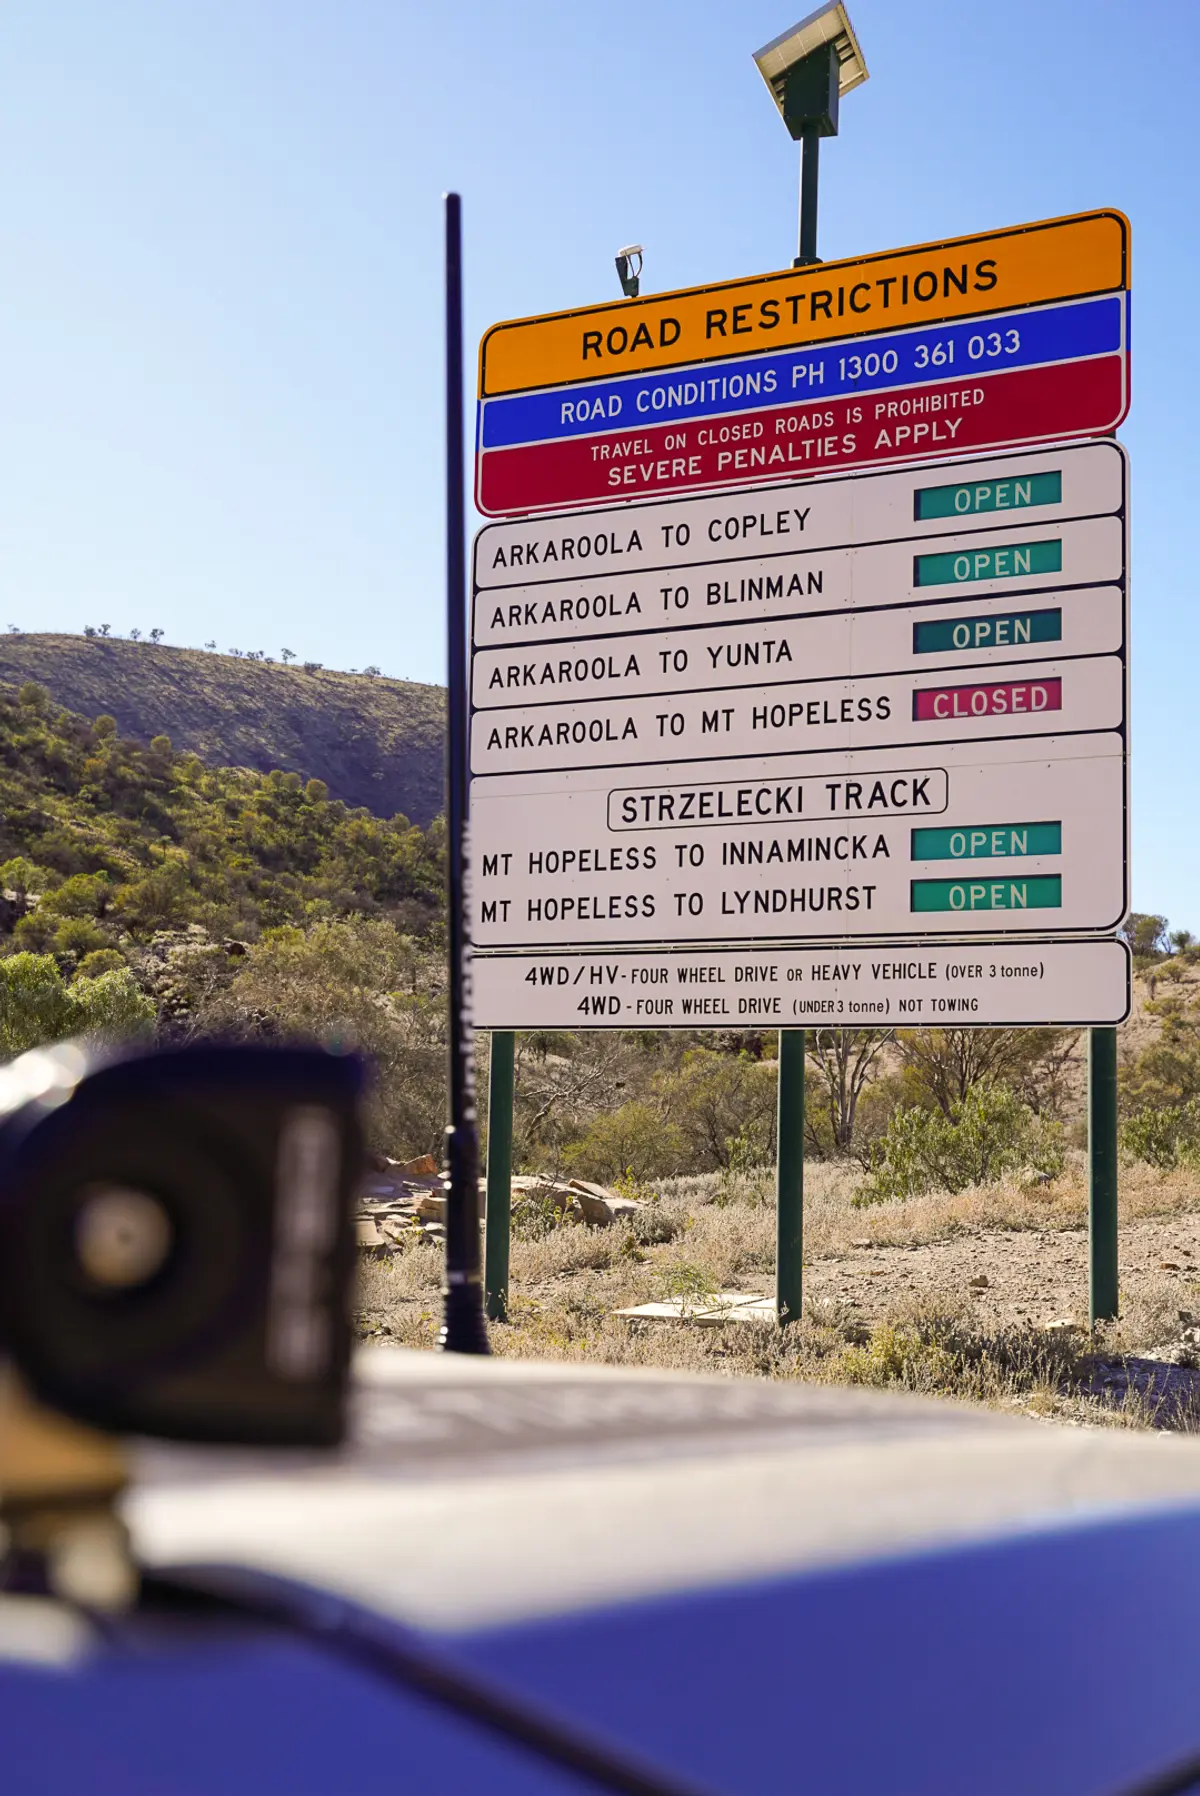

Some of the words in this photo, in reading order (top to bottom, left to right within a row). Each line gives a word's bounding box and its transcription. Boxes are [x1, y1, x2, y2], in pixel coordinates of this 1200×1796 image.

[583, 318, 680, 360] ROAD
[706, 258, 999, 340] RESTRICTIONS
[562, 395, 622, 424] ROAD
[636, 370, 777, 411] CONDITIONS
[793, 362, 823, 388] PH
[840, 350, 897, 380] 1300
[914, 340, 953, 368] 361
[968, 330, 1020, 359] 033
[591, 439, 652, 461] TRAVEL
[664, 432, 688, 450] ON
[698, 423, 763, 445] CLOSED
[774, 412, 835, 434] ROADS
[847, 407, 862, 423] IS
[876, 389, 984, 419] PROHIBITED
[608, 454, 702, 486] SEVERE
[718, 434, 857, 471] PENALTIES
[875, 418, 962, 449] APPLY
[953, 481, 1033, 514] OPEN
[493, 530, 642, 568] ARKAROOLA
[662, 524, 690, 547] TO
[709, 508, 810, 542] COPLEY
[953, 550, 1033, 581] OPEN
[491, 592, 641, 628] ARKAROOLA
[660, 586, 688, 610] TO
[706, 571, 824, 606] BLINMAN
[952, 619, 1033, 648] OPEN
[489, 655, 640, 689] ARKAROOLA
[659, 650, 687, 673] TO
[707, 640, 792, 668] YUNTA
[487, 717, 637, 750] ARKAROOLA
[656, 713, 684, 736] TO
[703, 709, 734, 733] MT
[751, 696, 892, 730] HOPELESS
[933, 687, 1049, 719] CLOSED
[621, 786, 804, 824] STRZELECKI
[826, 778, 930, 810] TRACK
[483, 854, 512, 876] MT
[529, 846, 656, 874] HOPELESS
[675, 844, 704, 867] TO
[721, 835, 891, 866] INNAMINCKA
[948, 830, 1029, 856] OPEN
[482, 900, 511, 923] MT
[528, 895, 655, 921] HOPELESS
[674, 893, 703, 916] TO
[722, 886, 876, 914] LYNDHURST
[948, 884, 1029, 910] OPEN
[677, 967, 725, 983] WHEEL
[735, 966, 777, 982] DRIVE
[787, 969, 802, 981] OR
[812, 964, 861, 980] HEAVY
[872, 963, 936, 979] VEHICLE
[946, 964, 982, 980] (OVER
[1000, 961, 1045, 980] tonne)
[682, 999, 729, 1014] WHEEL
[739, 998, 781, 1013] DRIVE
[849, 998, 889, 1014] tonne)
[899, 999, 923, 1012] NOT
[931, 998, 978, 1011] TOWING
